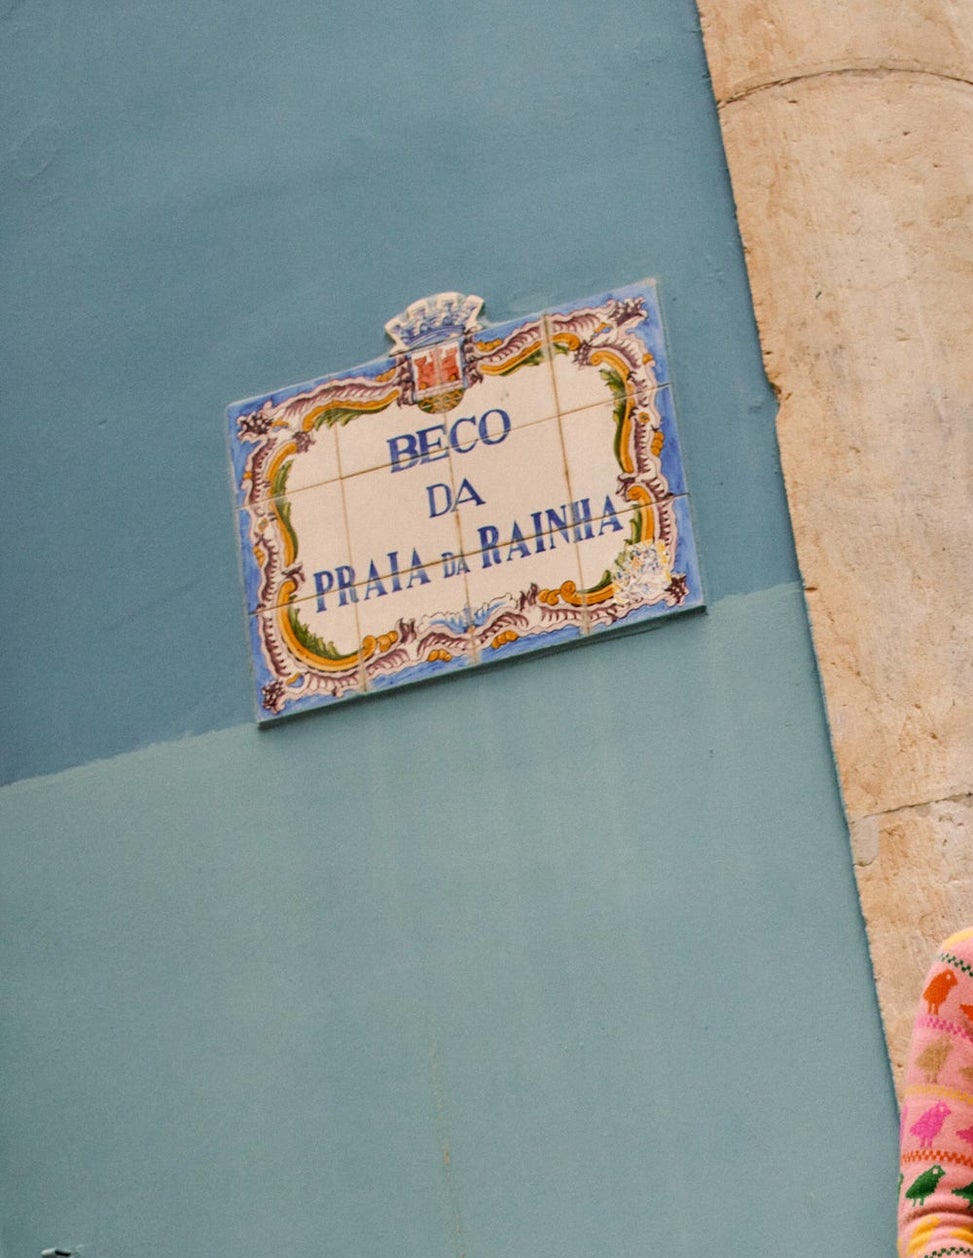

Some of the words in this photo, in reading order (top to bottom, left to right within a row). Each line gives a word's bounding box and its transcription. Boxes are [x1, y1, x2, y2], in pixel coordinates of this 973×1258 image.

[386, 409, 511, 473] BECO
[426, 478, 486, 518] DA
[313, 548, 431, 613] PRAIA
[441, 551, 470, 579] DA
[477, 494, 624, 569] RAINHA
